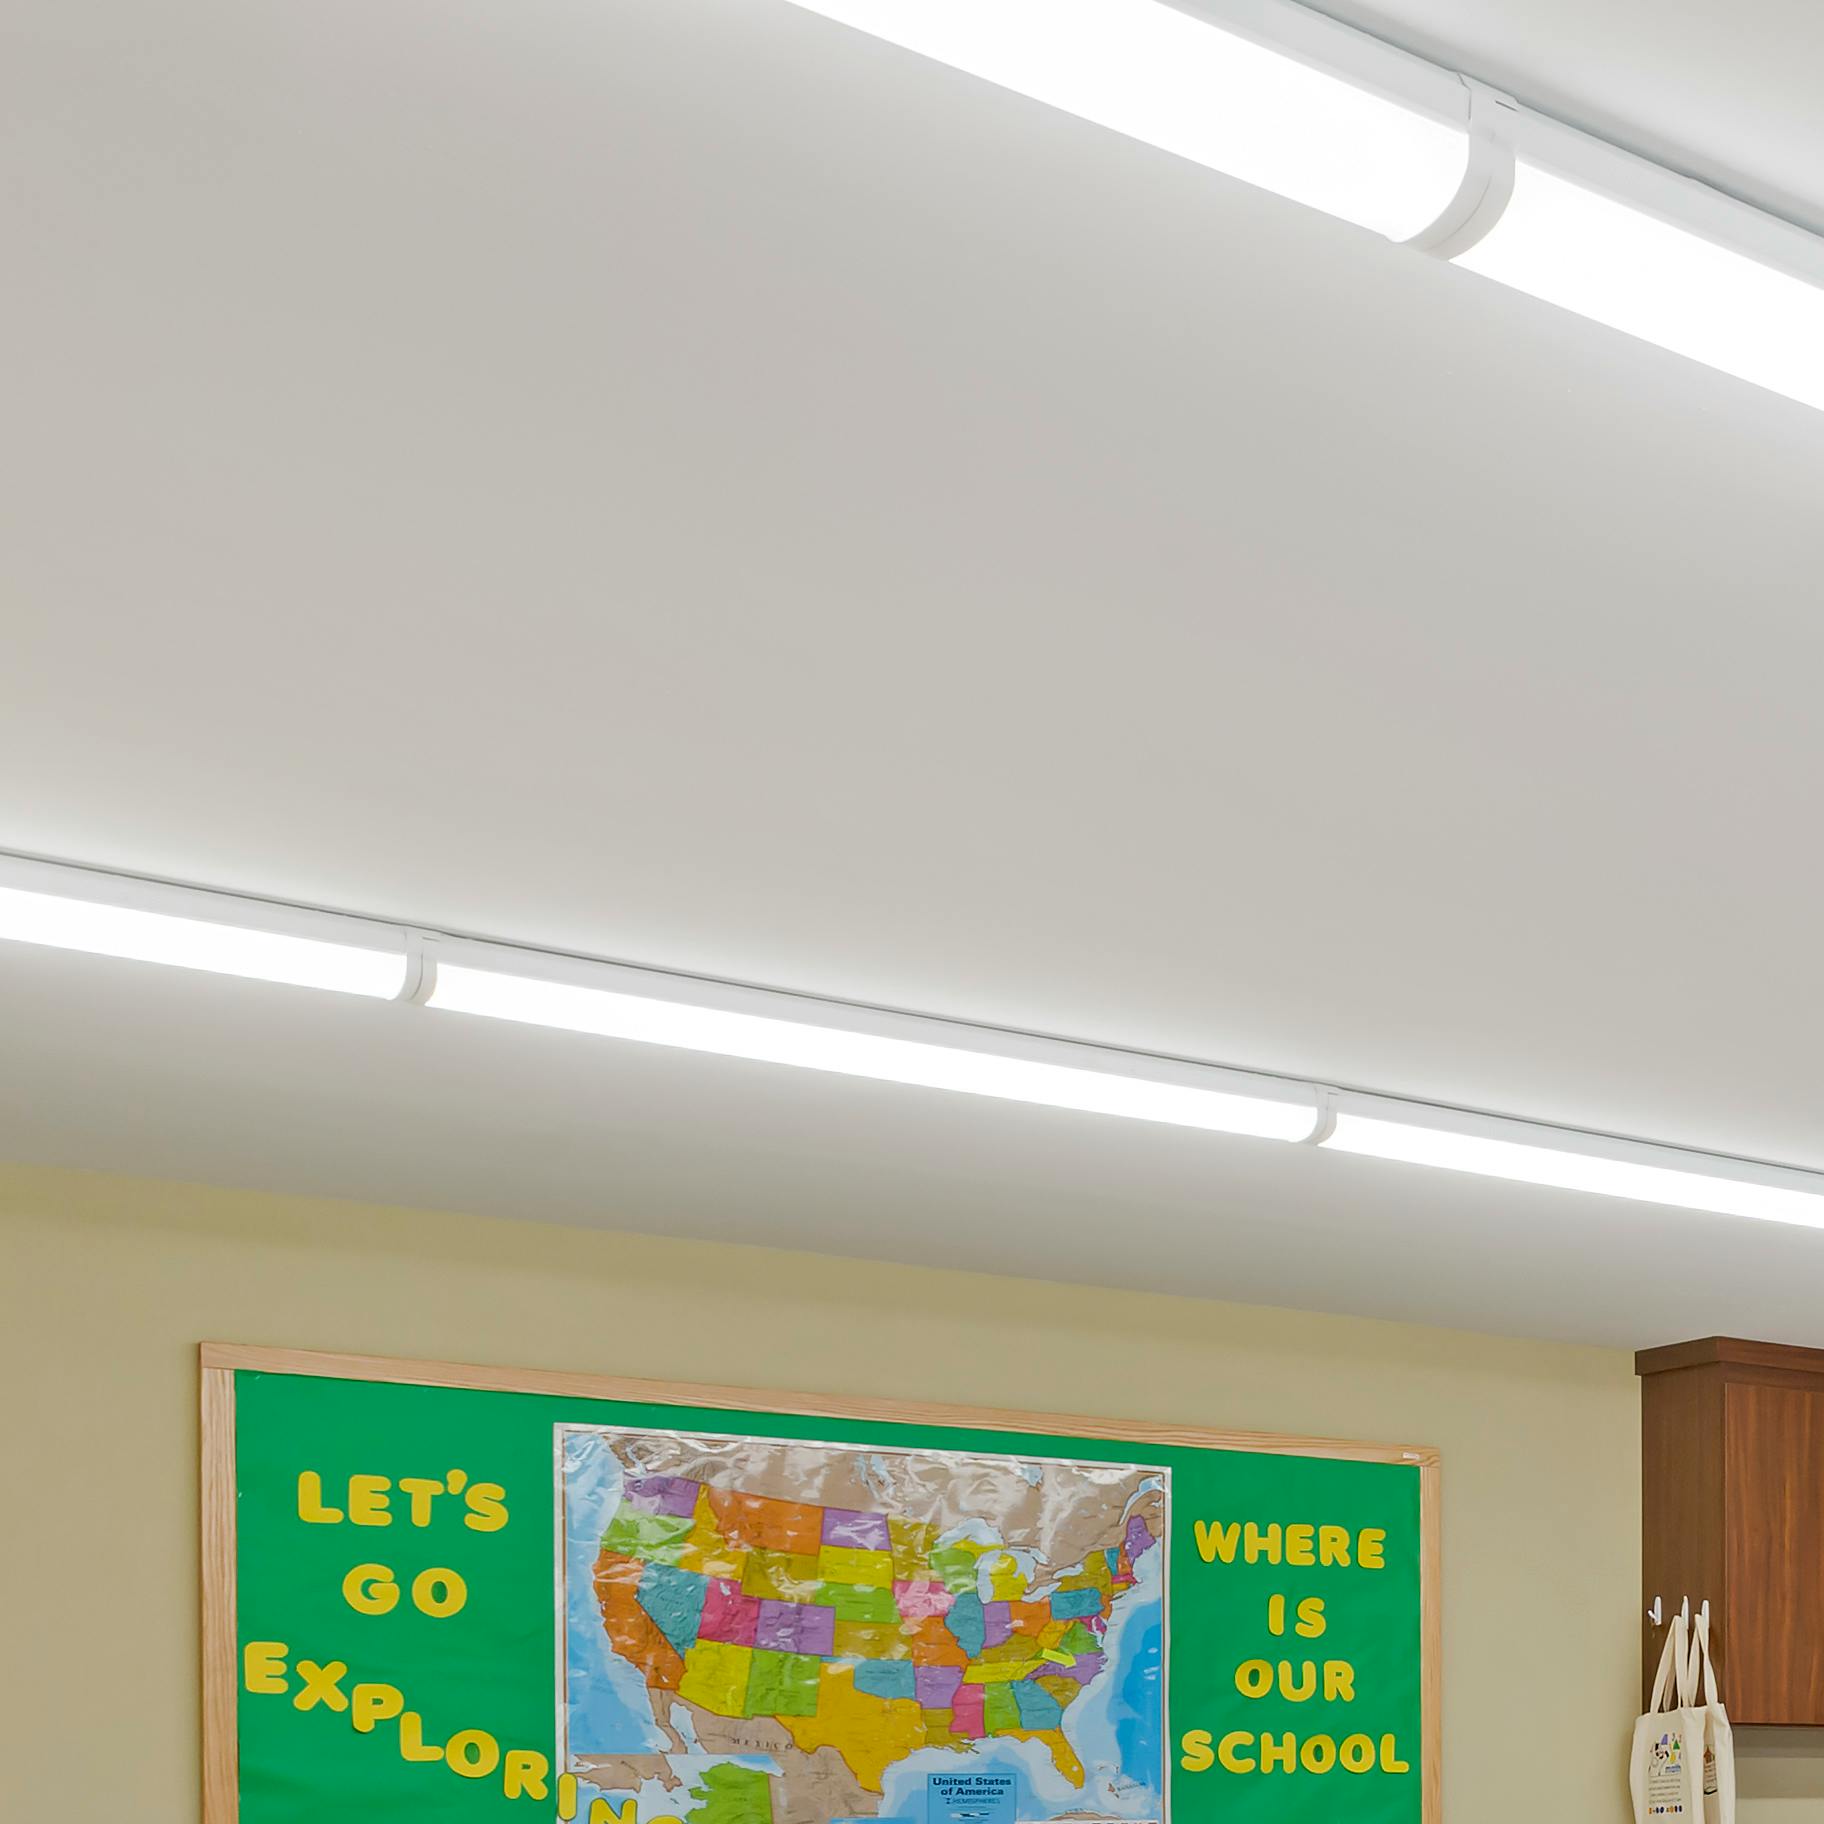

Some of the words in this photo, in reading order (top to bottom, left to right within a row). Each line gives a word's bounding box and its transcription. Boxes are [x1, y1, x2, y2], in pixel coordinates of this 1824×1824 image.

[298, 1469, 509, 1532] LET'S
[1194, 1520, 1387, 1569] WHERE
[342, 1563, 467, 1618] GO
[1268, 1594, 1327, 1638] IS
[1235, 1659, 1355, 1702] OUR
[1180, 1730, 1409, 1774] SCHOOL
[933, 1777, 974, 1786] United
[975, 1777, 1012, 1786] States
[940, 1787, 952, 1796] of
[954, 1786, 1005, 1797] America
